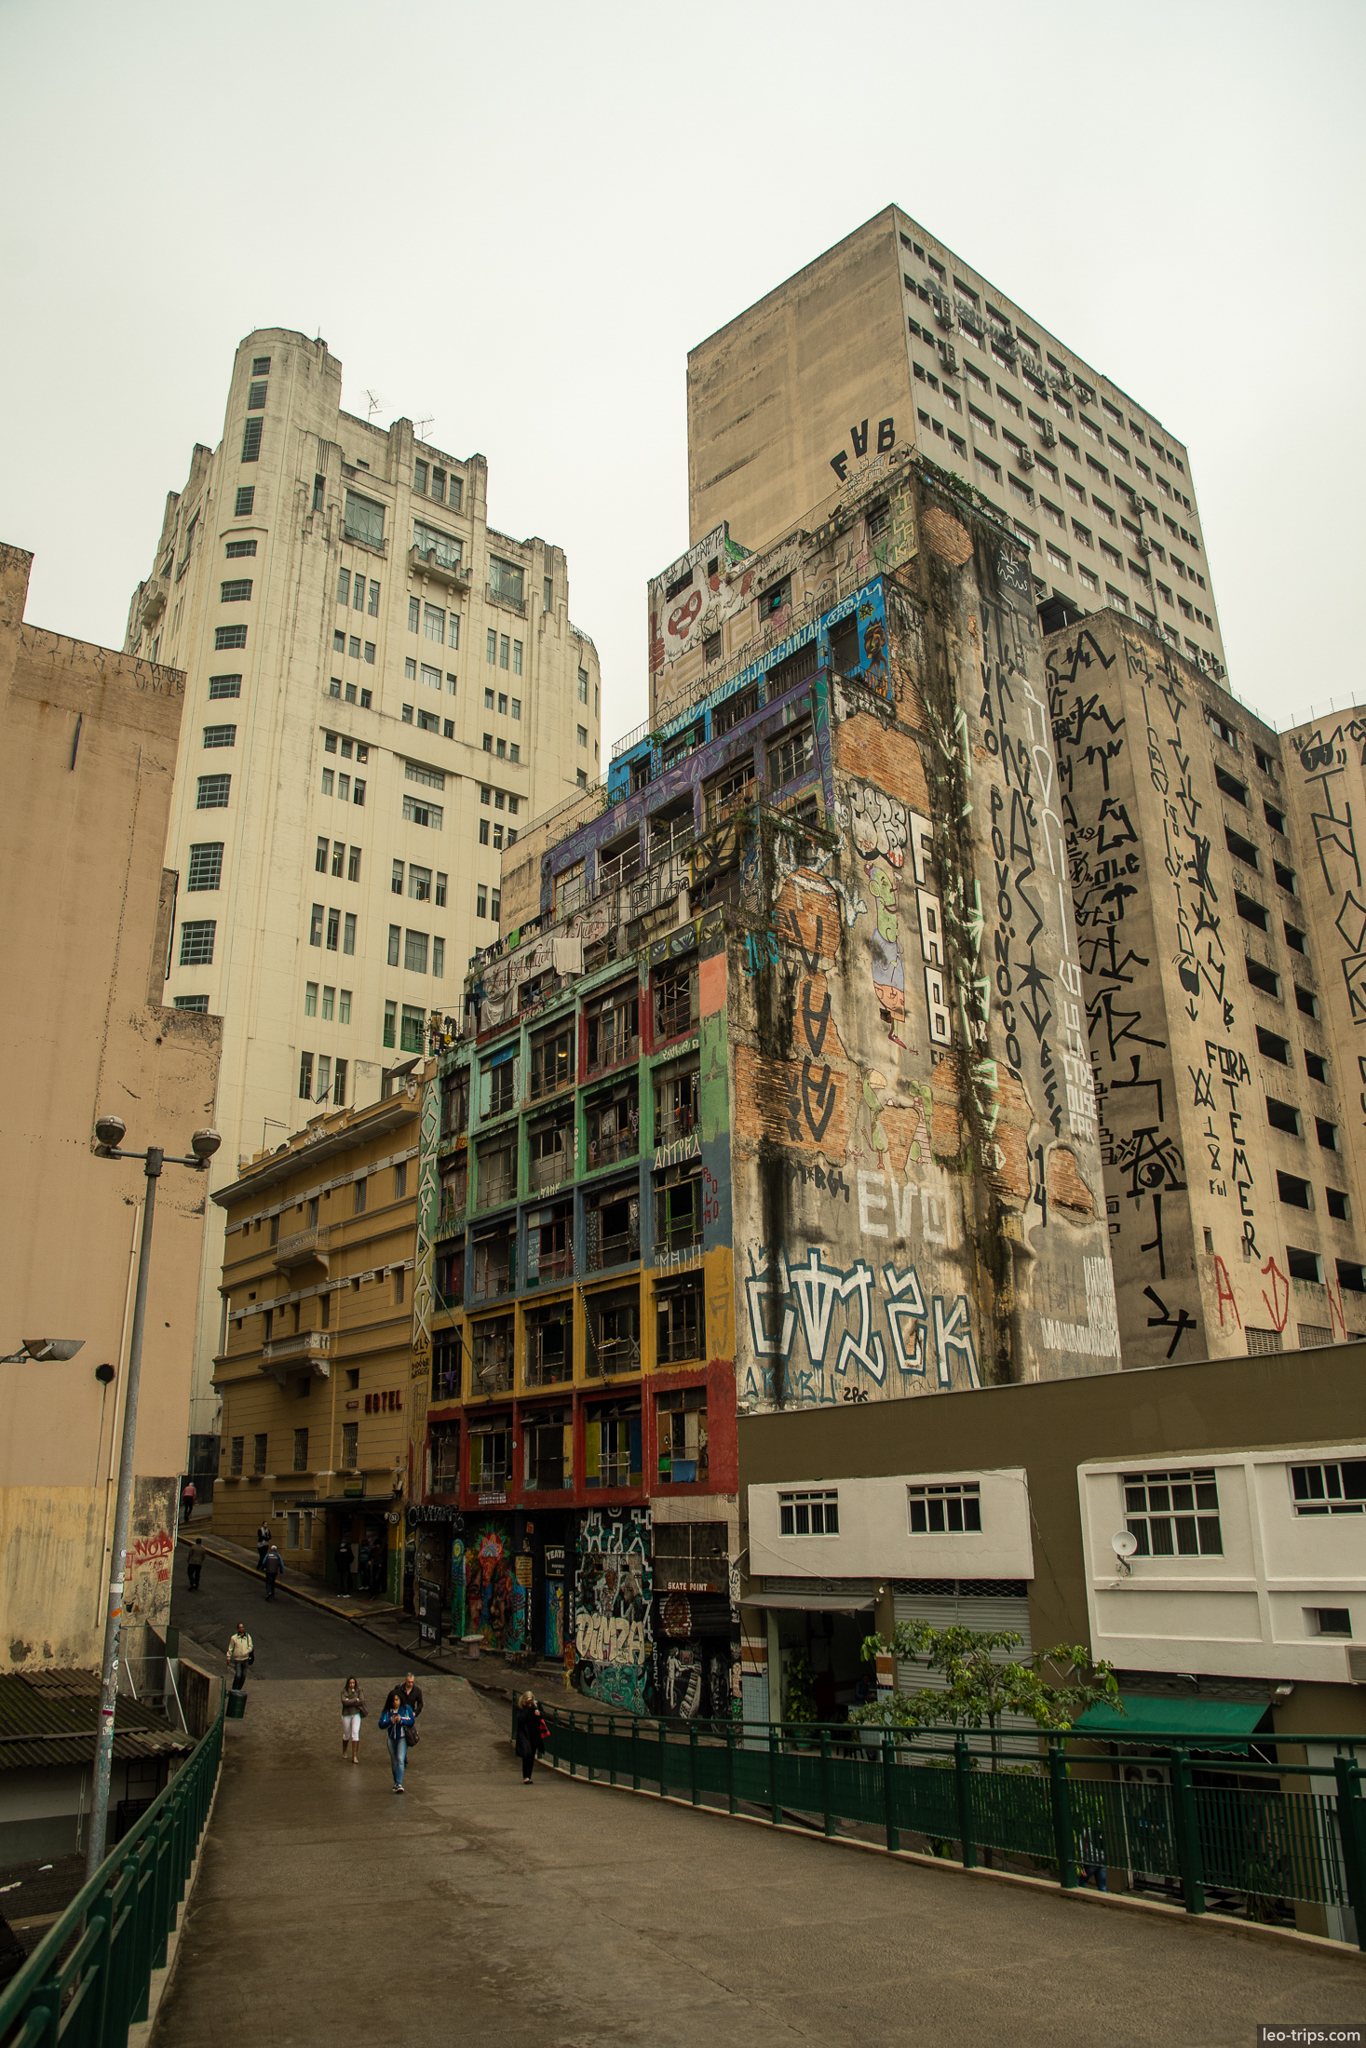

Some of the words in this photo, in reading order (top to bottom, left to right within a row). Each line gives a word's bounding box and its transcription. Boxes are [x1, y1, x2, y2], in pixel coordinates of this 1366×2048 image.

[909, 810, 953, 1049] FAB
[1205, 1039, 1251, 1086] FORA
[1222, 1077, 1262, 1261] TEMER
[365, 1390, 403, 1414] HOTEL
[667, 1581, 687, 1591] SKATE
[689, 1582, 708, 1592] POINT
